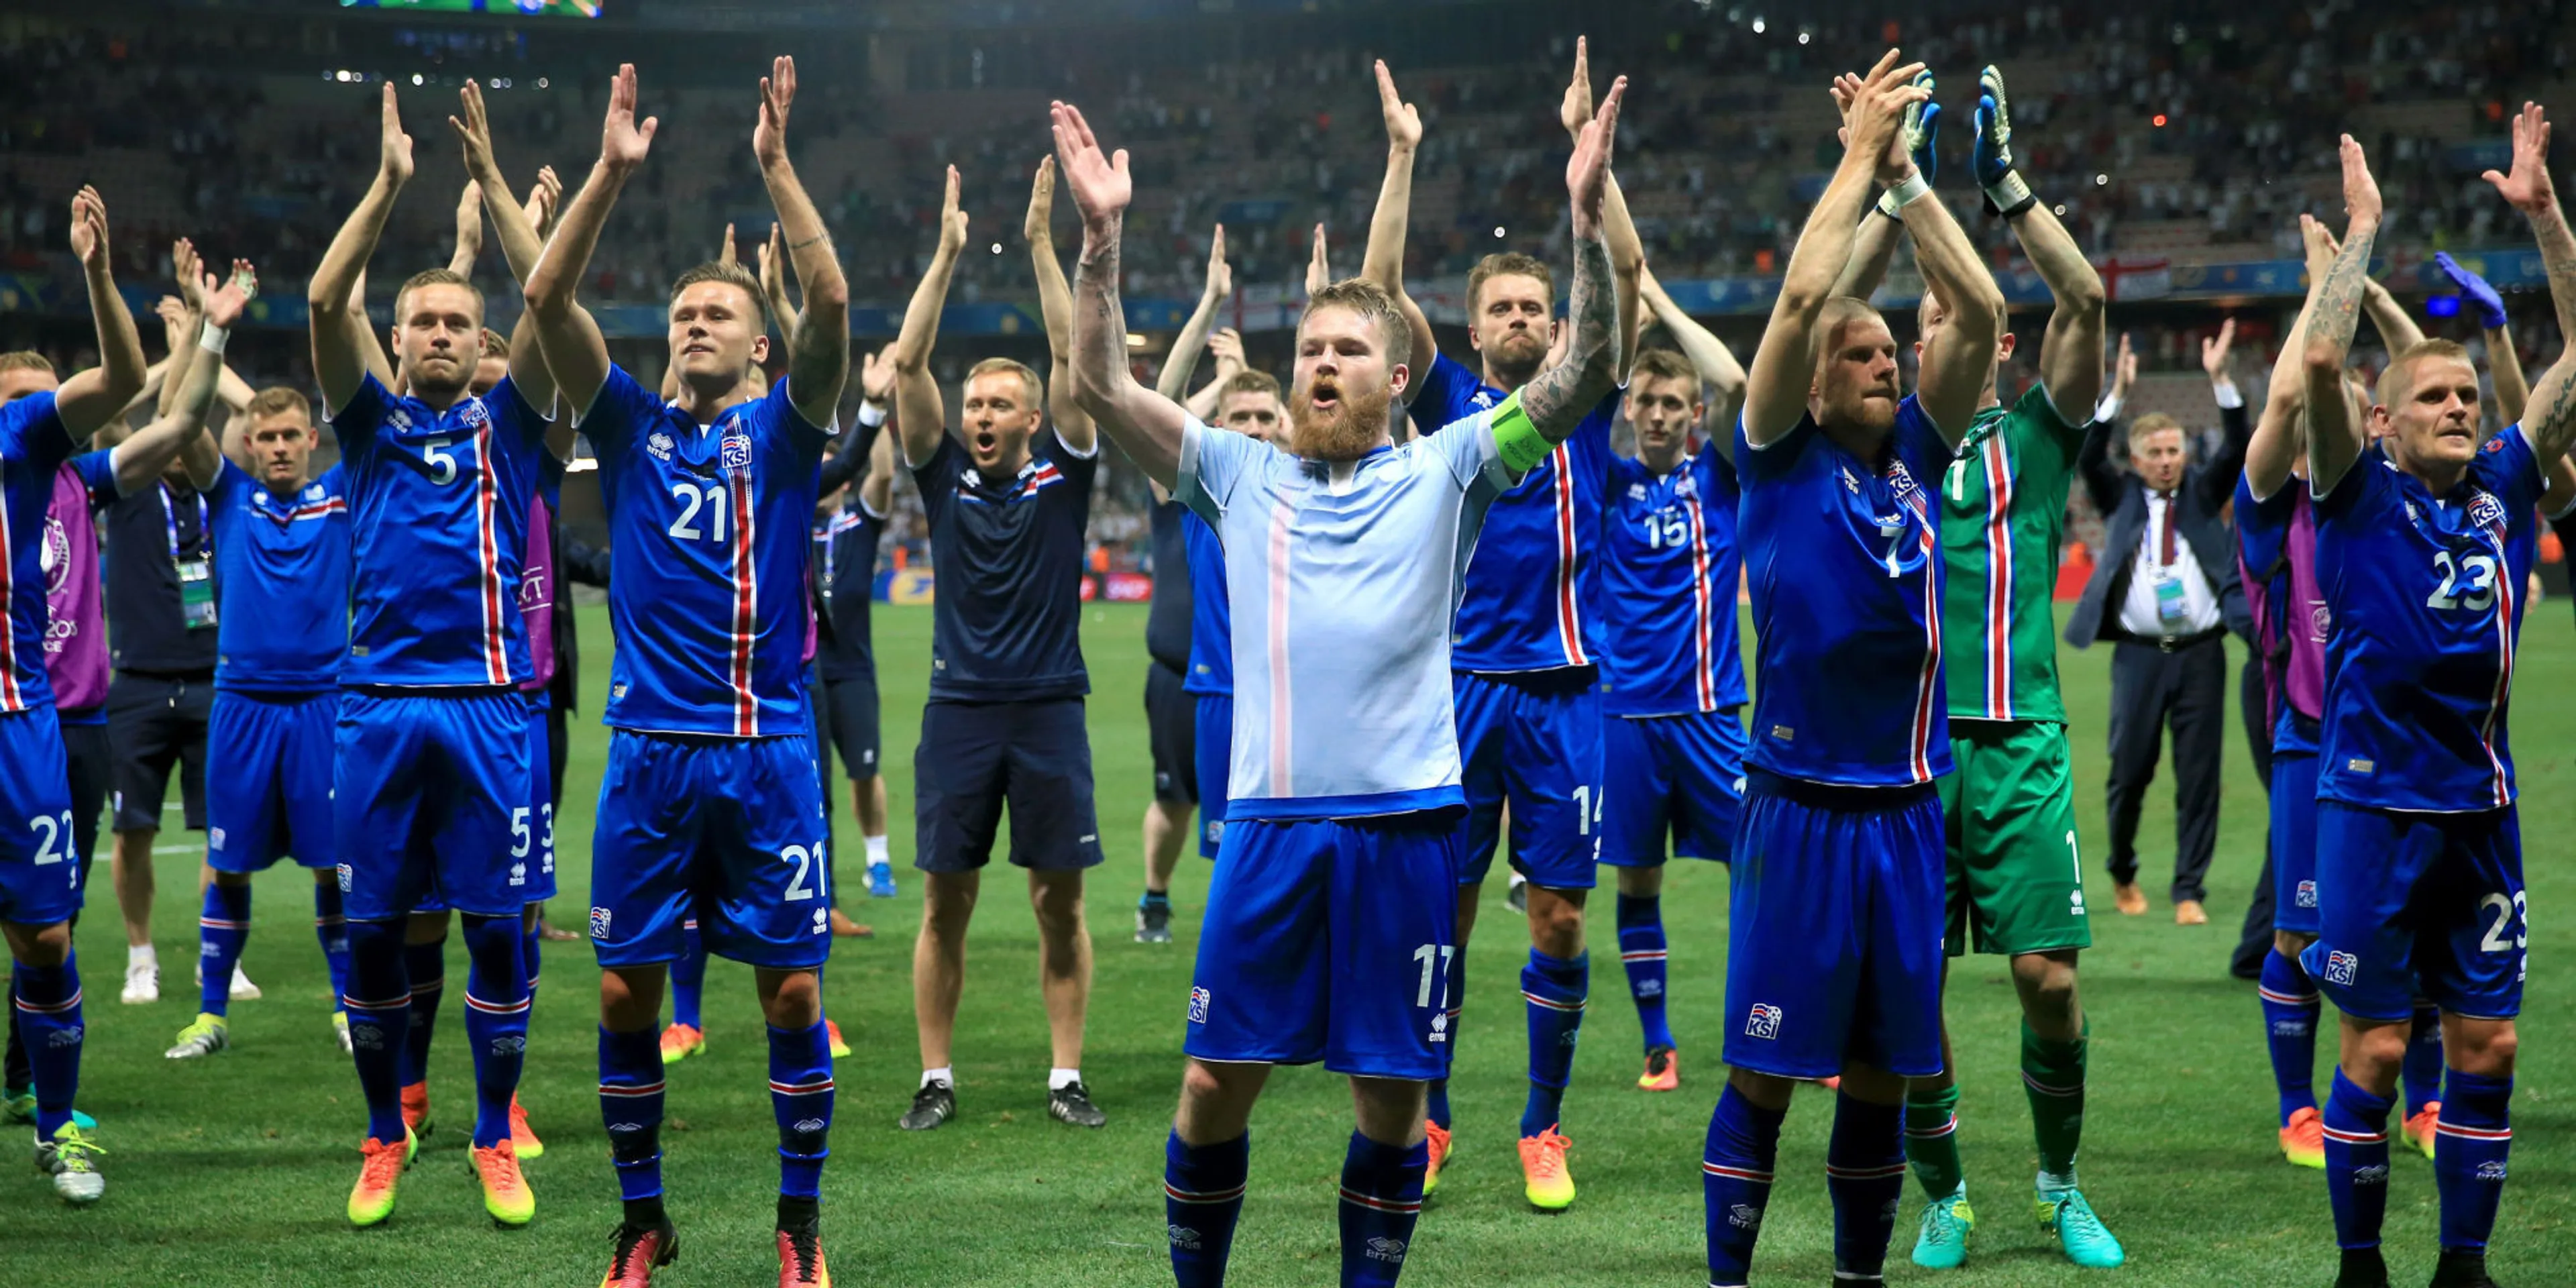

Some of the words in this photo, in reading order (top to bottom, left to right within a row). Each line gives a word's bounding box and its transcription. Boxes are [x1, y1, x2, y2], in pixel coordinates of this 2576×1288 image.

[424, 437, 457, 486] 5
[1949, 459, 1966, 500] 1
[669, 483, 726, 542] 21
[1644, 513, 1688, 549] 15
[1880, 525, 1905, 578] 7
[2426, 551, 2496, 611] 23
[30, 809, 74, 866] 22
[511, 807, 530, 857] 5
[541, 802, 553, 847] 3
[780, 841, 826, 902] 21
[2065, 830, 2080, 884] 1
[2481, 890, 2528, 952] 23
[1413, 944, 1456, 1009] 17
